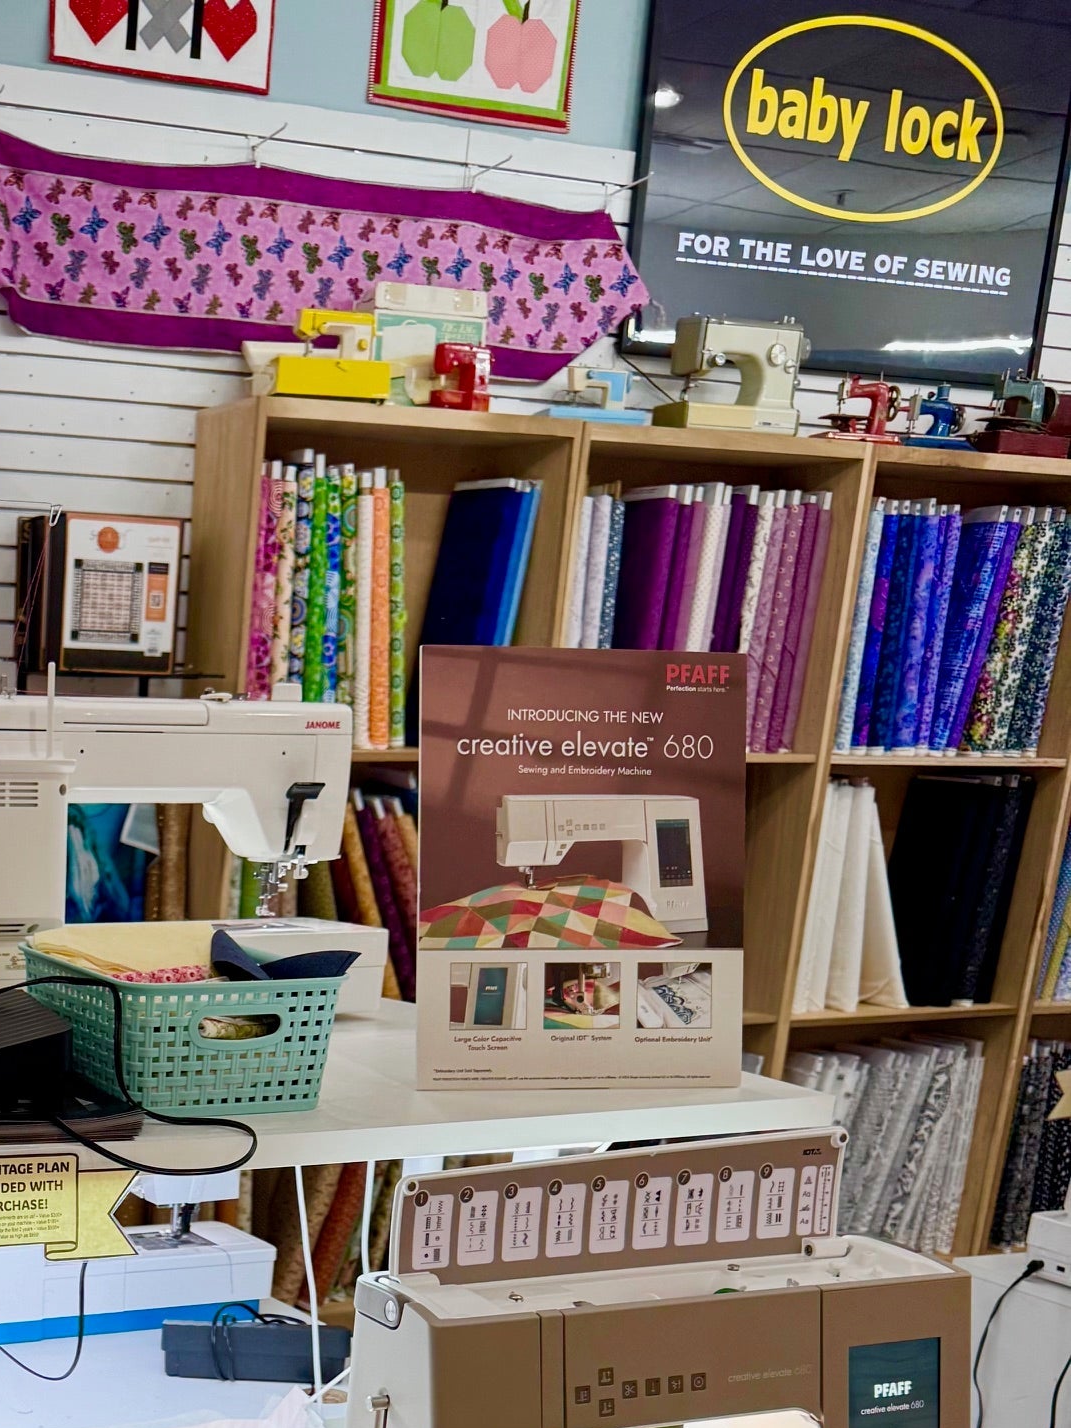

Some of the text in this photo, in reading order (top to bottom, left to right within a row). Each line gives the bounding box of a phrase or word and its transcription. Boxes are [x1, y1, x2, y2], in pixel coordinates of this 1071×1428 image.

[746, 68, 988, 163] baby lock
[677, 232, 1011, 287] FOR THE LOVE OF SEWING
[666, 664, 730, 685] PFAFF
[507, 708, 664, 725] INTRODUCING THE NEW
[305, 721, 341, 730] JANOME
[456, 732, 553, 757] creative
[663, 734, 715, 760] 680
[517, 764, 652, 778] Sewing and Embroidery Machine
[490, 1036, 522, 1044] Capacitive
[550, 1035, 575, 1043] Original
[634, 1036, 661, 1044] Optional
[662, 1036, 697, 1044] Embroidery
[36, 1161, 70, 1173] PLAN
[29, 1180, 64, 1191] WITH
[728, 1370, 761, 1383] creative
[762, 1367, 792, 1379] elevate
[873, 1380, 913, 1399] PFAFF
[860, 1399, 924, 1416] creative elevate 680
